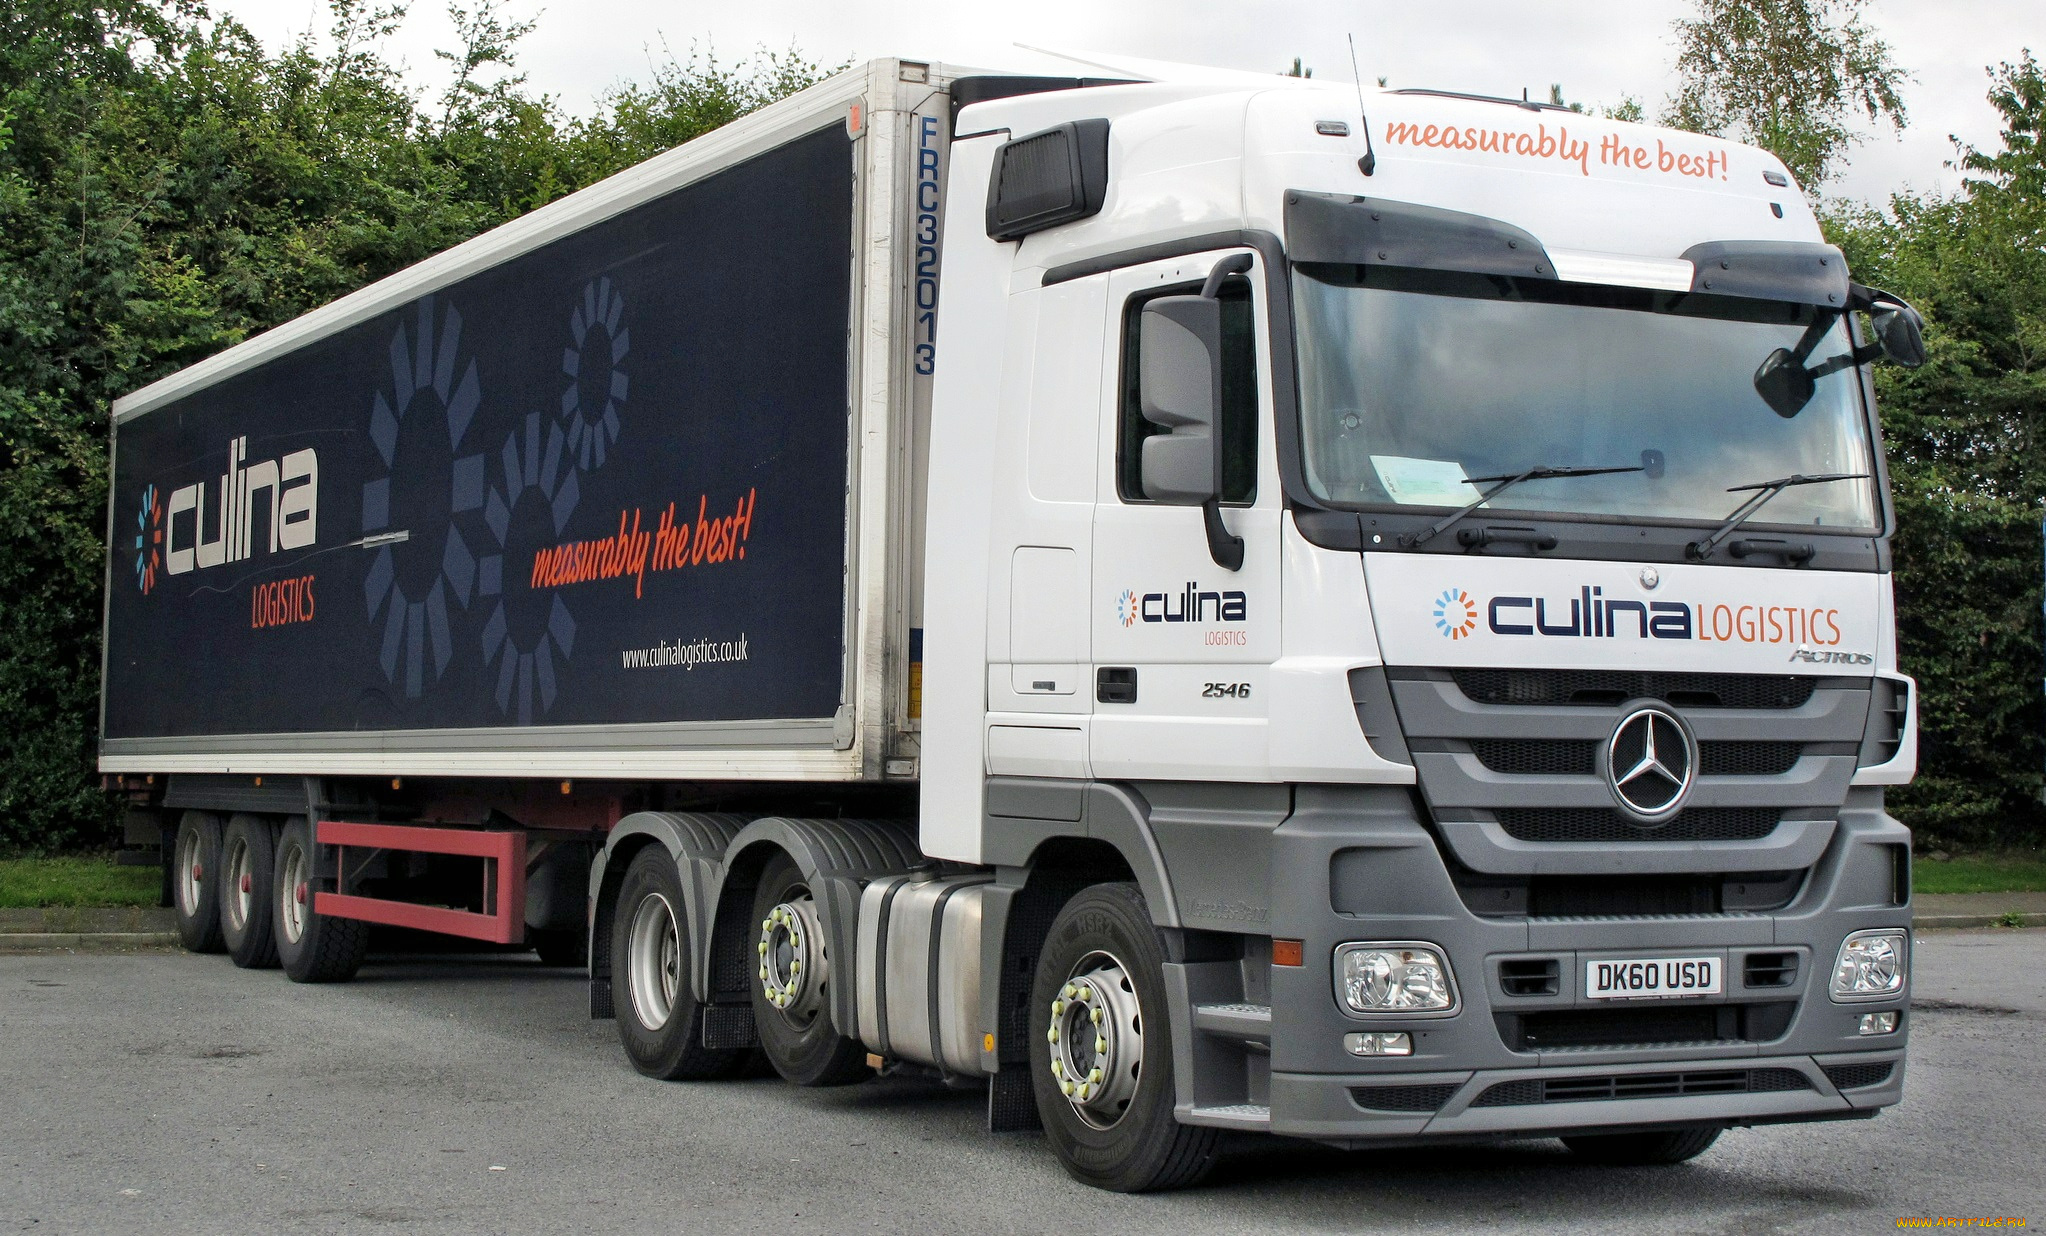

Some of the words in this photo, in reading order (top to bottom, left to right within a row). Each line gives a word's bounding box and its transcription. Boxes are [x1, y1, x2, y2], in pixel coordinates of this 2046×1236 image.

[1386, 121, 1589, 176] measurably
[1600, 133, 1653, 170] the
[1657, 138, 1729, 181] best!
[915, 116, 939, 376] FRC32013
[166, 435, 319, 576] culina
[531, 507, 650, 600] measurably
[652, 501, 690, 571] the
[691, 487, 756, 566] best!
[251, 575, 315, 629] LOGISTICS
[1141, 581, 1247, 623] culina
[1487, 585, 1692, 640] culina
[1697, 603, 1842, 646] LOGISTICS
[622, 632, 748, 671] www.culinalogistics.co.uk
[1204, 631, 1247, 646] LOGISTICS
[1201, 682, 1252, 699] 2546
[1597, 963, 1659, 990] DK60
[1666, 962, 1711, 989] USD
